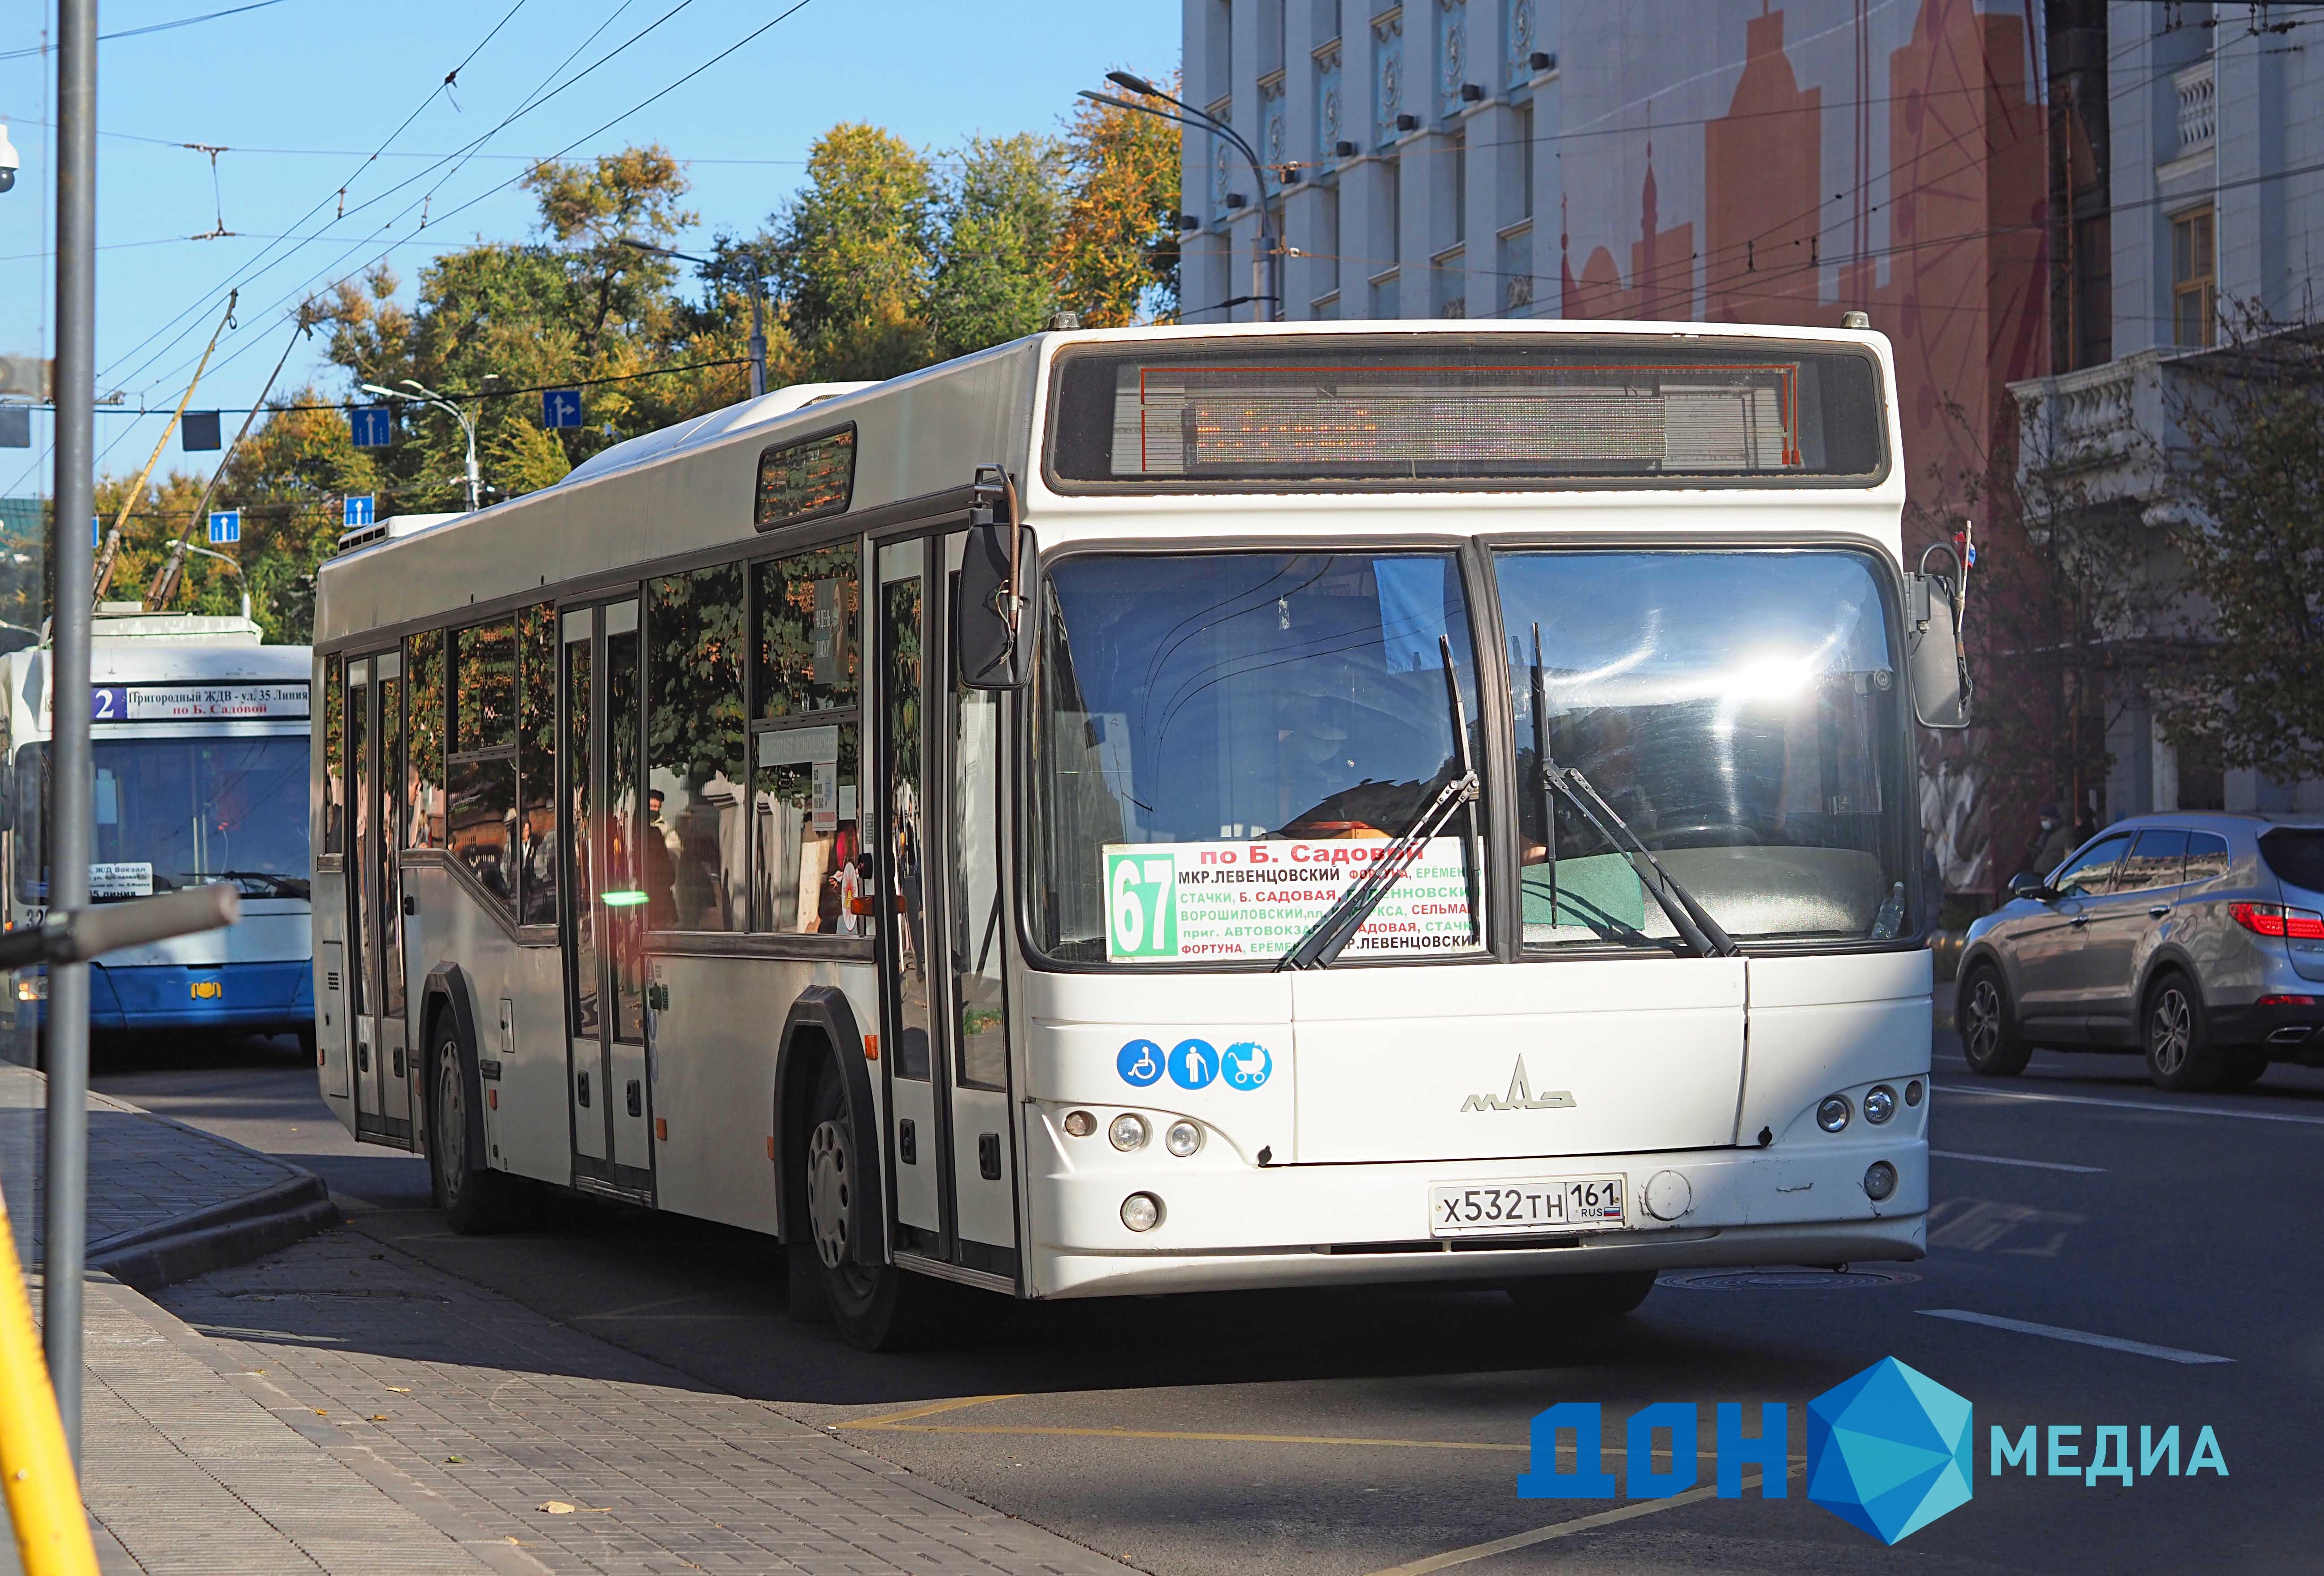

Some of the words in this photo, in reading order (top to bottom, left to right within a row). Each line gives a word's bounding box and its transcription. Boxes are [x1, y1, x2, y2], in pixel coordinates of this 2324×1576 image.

[815, 609, 831, 629] НАДЕНЬ
[816, 640, 829, 658] МАСКУ
[95, 689, 114, 718] 2
[129, 692, 201, 706] Пригородный
[205, 690, 232, 702] ЖДВ
[241, 693, 256, 704] ул.
[259, 690, 270, 701] 35
[273, 689, 308, 701] Линия
[194, 705, 206, 714] Б.
[210, 703, 267, 714] Садовой
[1201, 850, 1237, 865] по
[1249, 845, 1278, 863] Б.
[1179, 864, 1340, 885] МКР.ЛЕВЕНЦОВСКИЙ
[1349, 867, 1412, 881] ФОРУНА,
[1113, 859, 1173, 952] 67
[1181, 892, 1236, 905] СТАЧКИ,
[1240, 892, 1251, 902] Б.
[1256, 889, 1341, 904] САДОВАЯ,
[1412, 904, 1471, 915] СЕЛЬМА
[1184, 929, 1219, 940] приг.
[1358, 922, 1421, 935] АДОВАЯ,
[1425, 921, 1471, 932] СТАЧК
[1181, 943, 1246, 955] ФОРТУНА,
[1443, 1189, 1563, 1222] Х532ТН
[1570, 1182, 1614, 1207] 161
[1581, 1208, 1603, 1217] RUS
